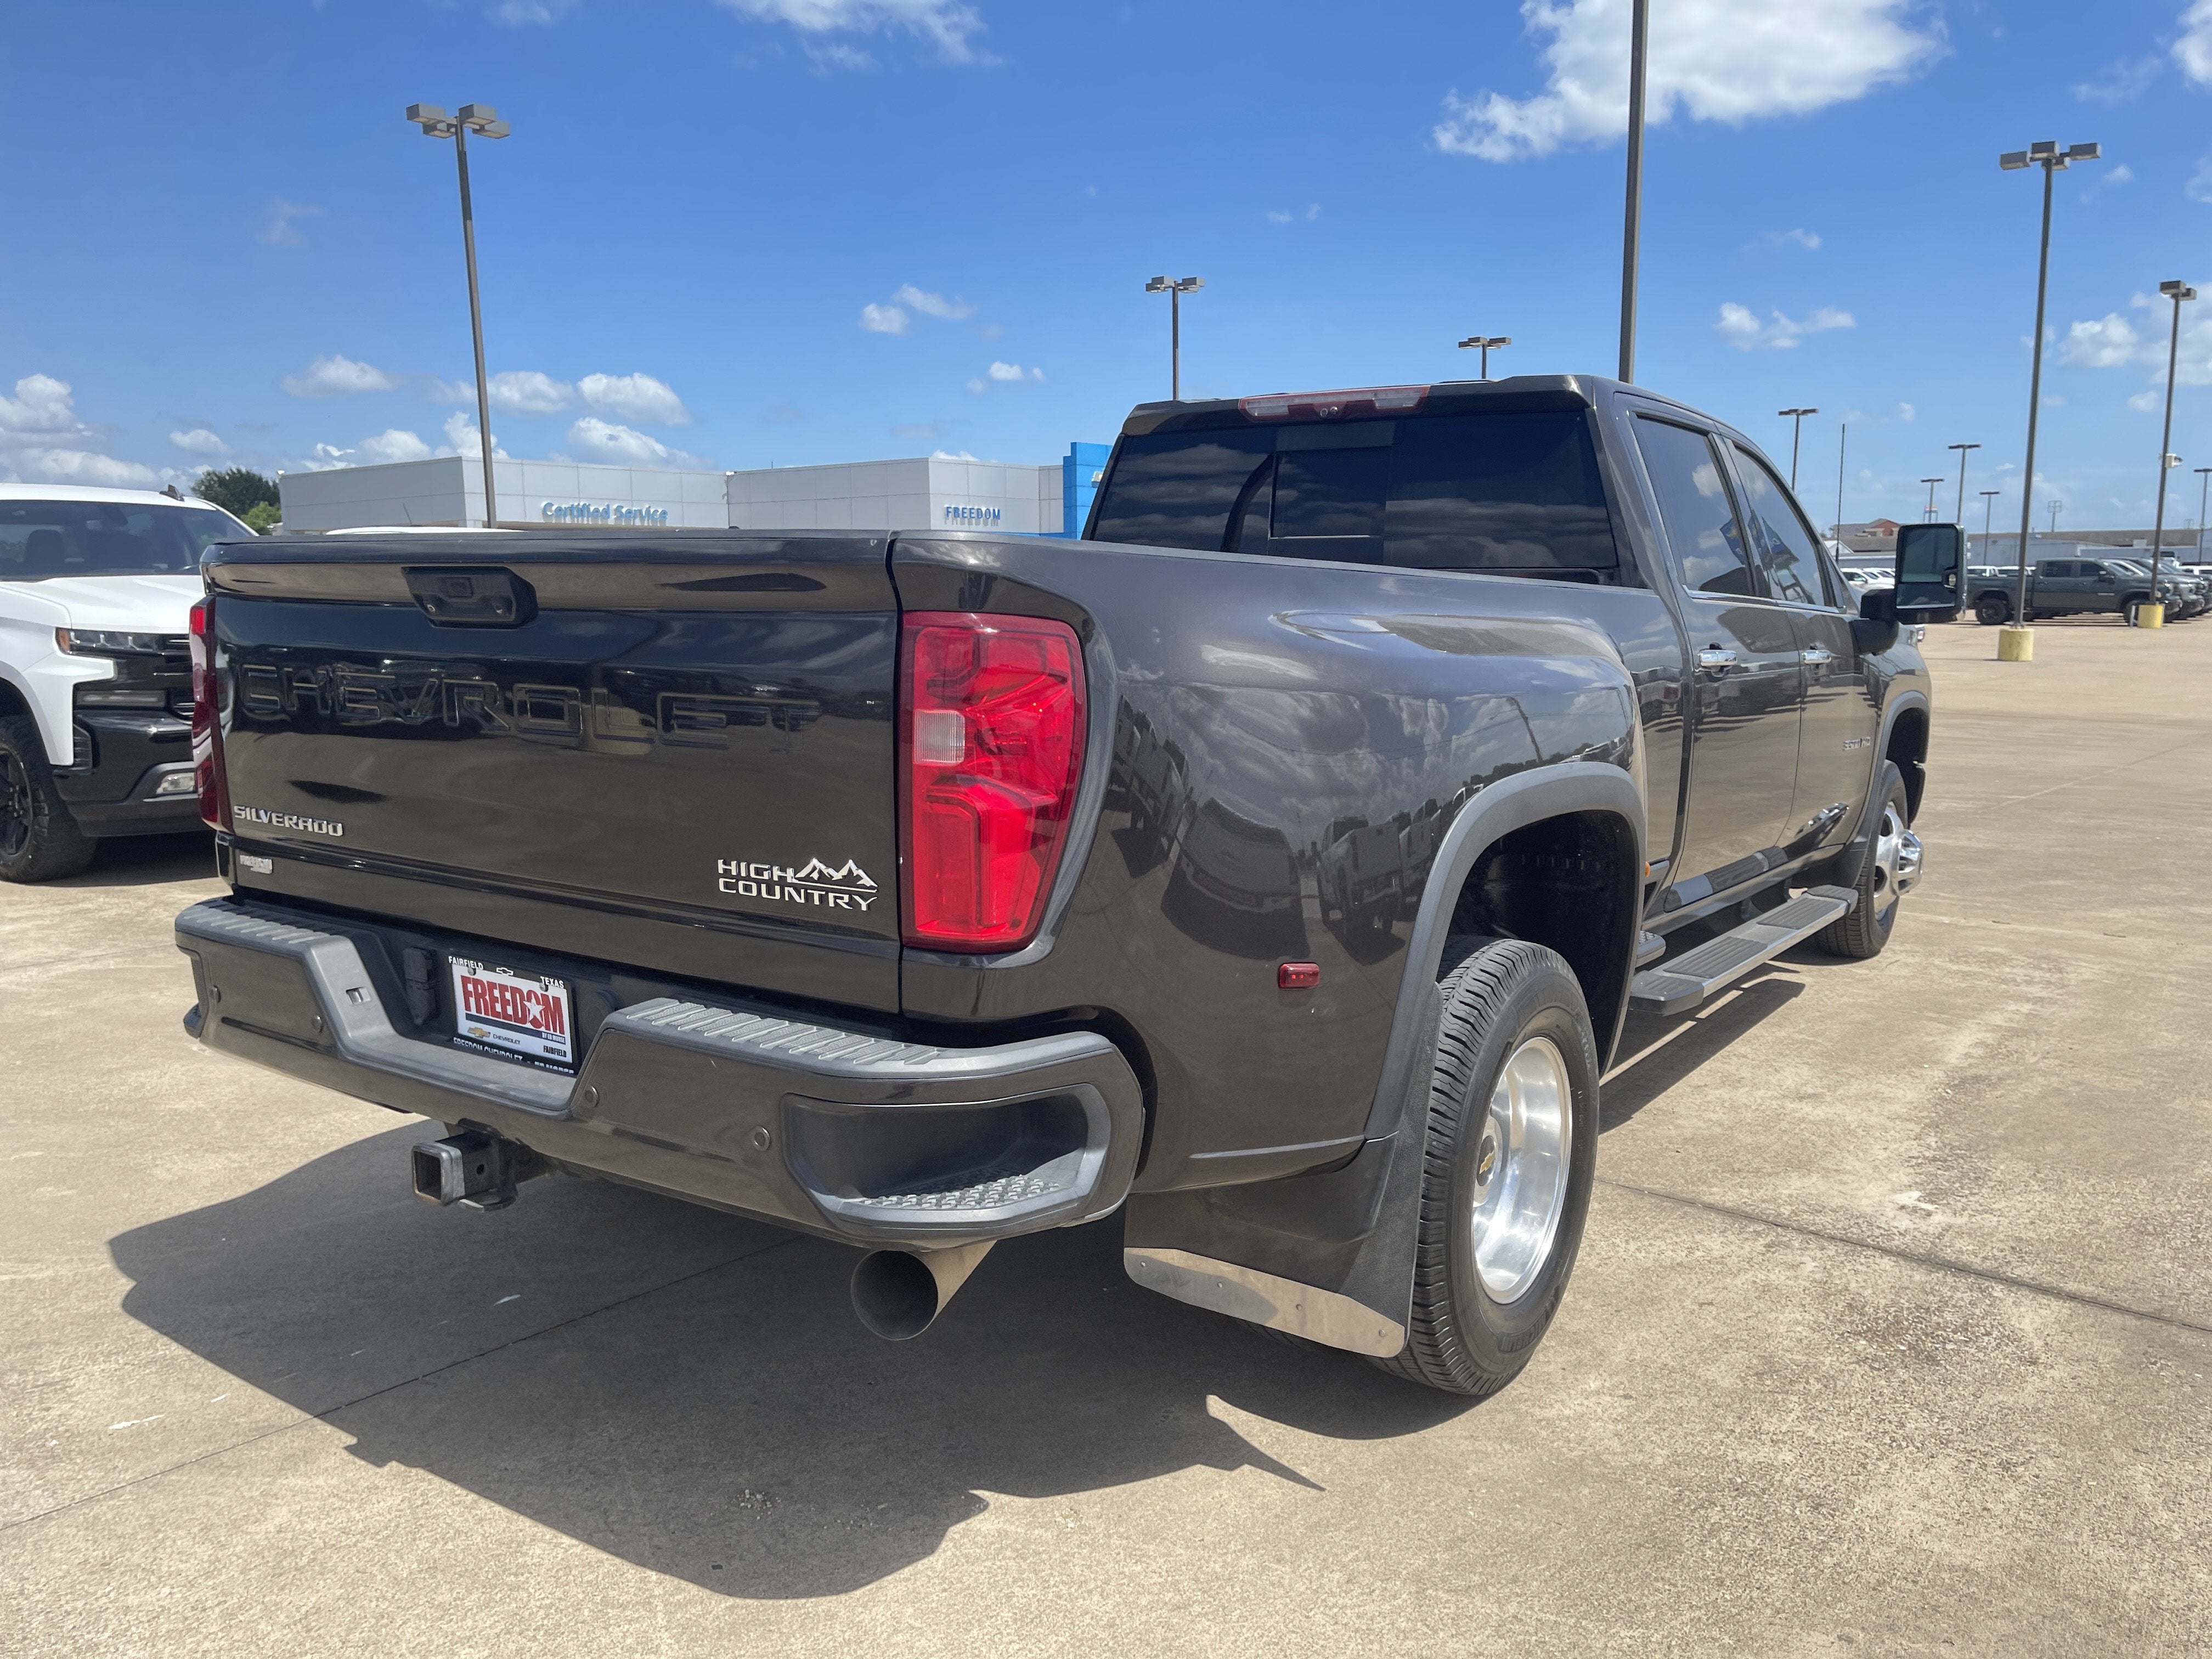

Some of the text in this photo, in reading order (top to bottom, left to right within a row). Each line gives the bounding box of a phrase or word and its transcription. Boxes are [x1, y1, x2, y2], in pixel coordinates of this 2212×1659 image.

[543, 502, 668, 519] Certified Service
[946, 506, 1001, 520] FREEDOM
[234, 805, 343, 837] SILVERADO
[718, 859, 795, 883] HIGH
[719, 878, 878, 911] COUNTRY
[448, 956, 565, 989] FAIRFIELD TEXAS
[461, 975, 565, 1035] FREEDOM
[493, 1034, 521, 1045] CHEVROLET
[543, 1045, 567, 1058] FAIRFIELD
